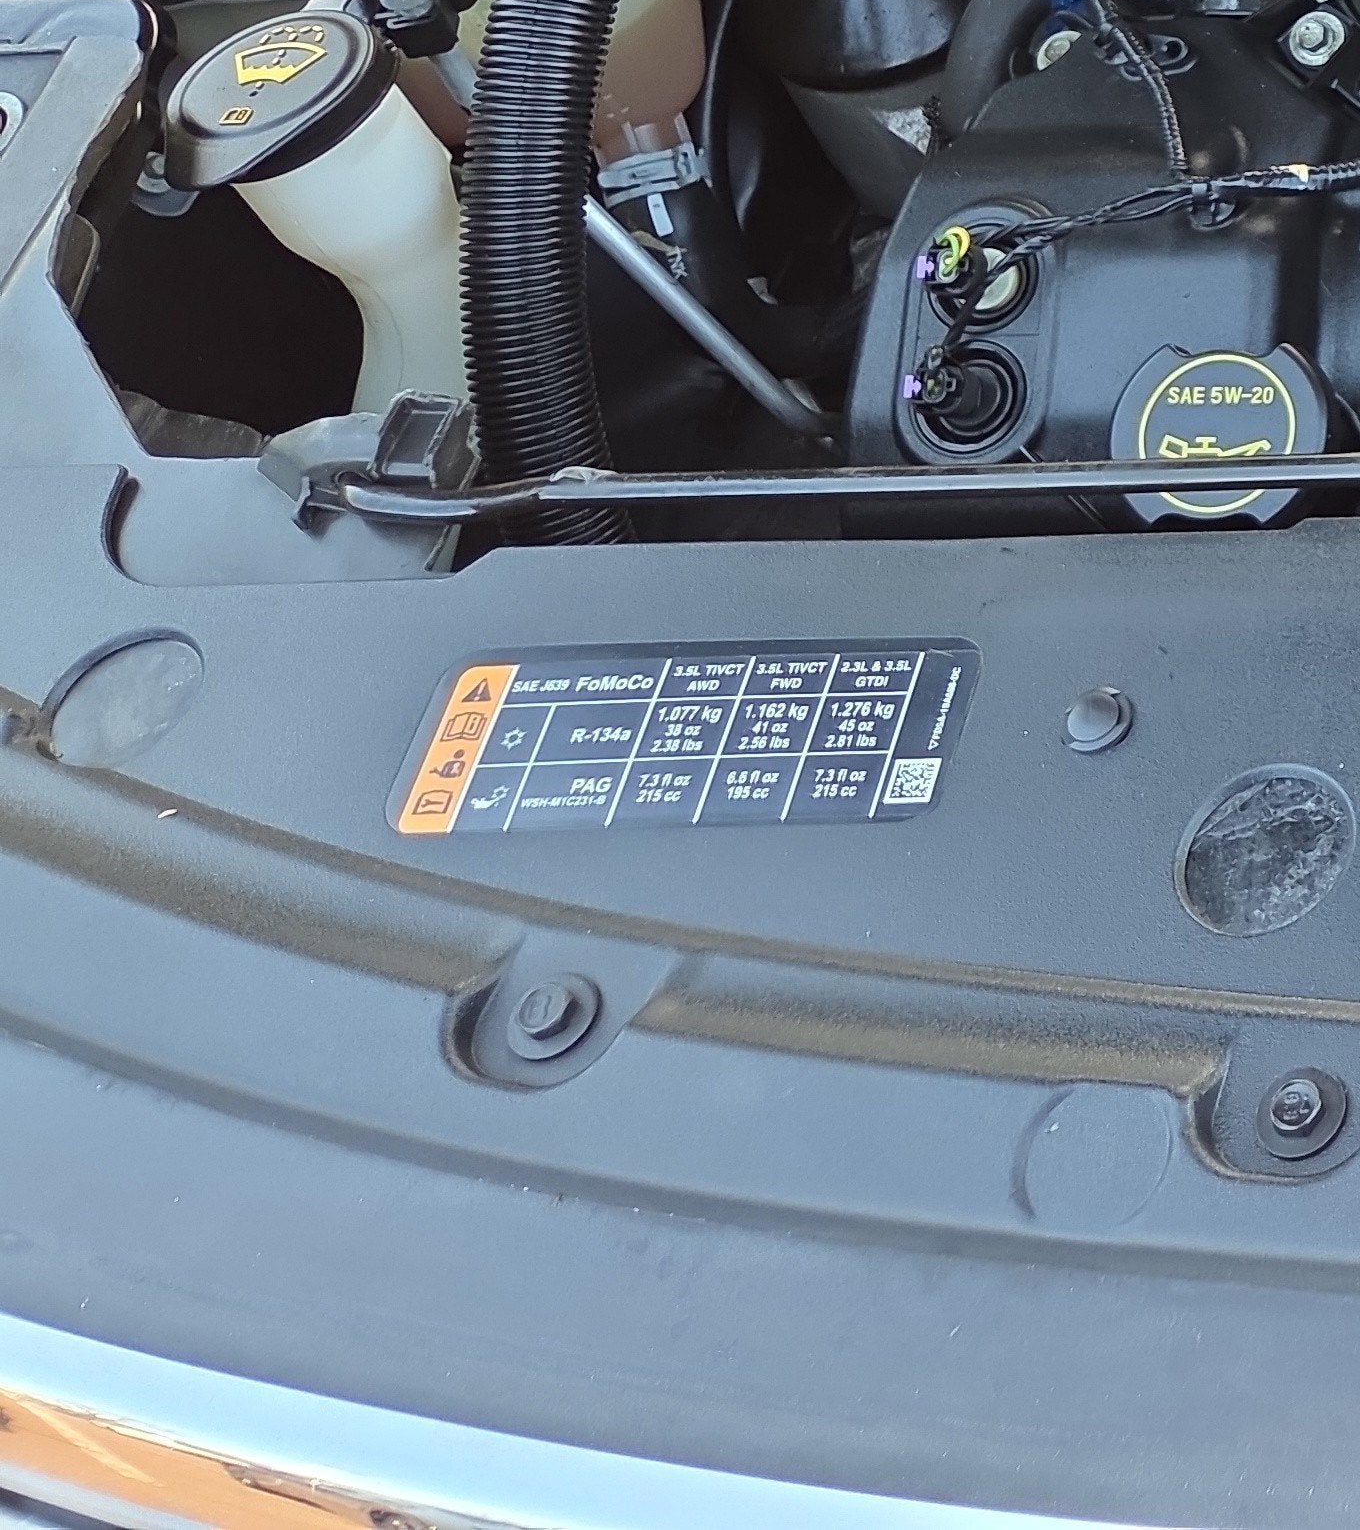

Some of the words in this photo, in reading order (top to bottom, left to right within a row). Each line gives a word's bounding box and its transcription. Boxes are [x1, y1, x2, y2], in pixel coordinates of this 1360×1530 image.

[1167, 386, 1206, 404] SAE
[1210, 386, 1275, 404] 5W-20
[673, 666, 701, 677] 3.5L
[756, 663, 784, 675] 3.5L
[841, 661, 869, 673] 2.3L
[871, 661, 881, 672] &
[884, 660, 912, 672] 3.5L
[512, 680, 540, 692] SAE
[575, 675, 654, 692] FoMoCo
[687, 680, 720, 692] AWD
[770, 677, 803, 690] FWD
[855, 676, 889, 688] GTDI
[658, 705, 700, 722] 1.077
[701, 704, 723, 723] kg
[745, 703, 786, 719] 1.162
[788, 702, 809, 720] kg
[831, 701, 872, 718] 1.276
[873, 701, 895, 719] kg
[665, 724, 683, 736] 38
[684, 725, 702, 736] oz
[752, 721, 770, 735] 41
[771, 722, 789, 734] oz
[838, 719, 855, 732] 45
[857, 721, 875, 732] oz
[570, 726, 632, 744] R-134a
[825, 734, 853, 748] 2.81
[855, 734, 877, 748] lbs
[650, 739, 680, 753] 2.38
[682, 738, 703, 752] lbs
[738, 736, 767, 750] 2.56
[769, 736, 791, 749] lbs
[638, 773, 659, 788] 7.3
[673, 775, 692, 786] oz
[762, 772, 780, 783] oz
[815, 769, 835, 782] 7.3
[850, 770, 867, 782] oz
[570, 777, 613, 794] PAG
[812, 784, 838, 798] 215
[840, 786, 857, 797] cc
[636, 789, 663, 803] 215
[664, 790, 682, 802] cc
[727, 786, 750, 800] 195
[752, 787, 770, 799] cc
